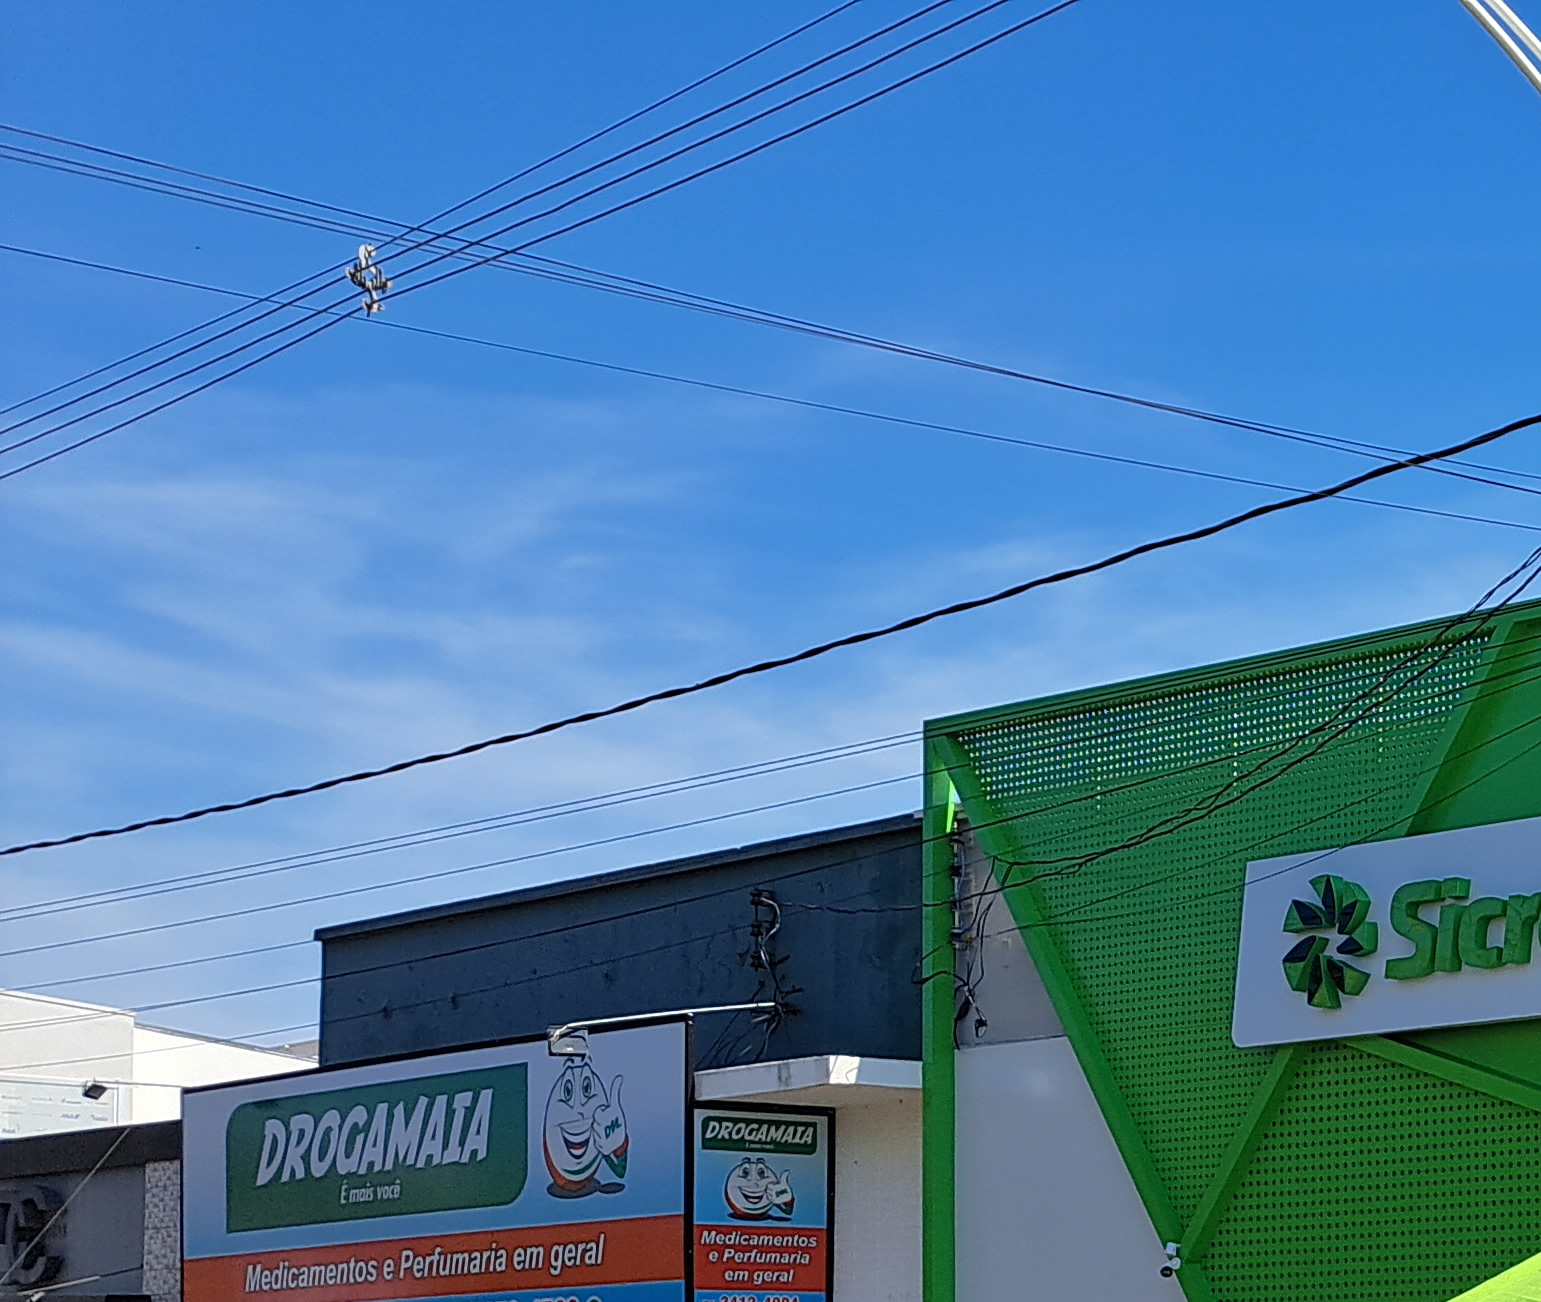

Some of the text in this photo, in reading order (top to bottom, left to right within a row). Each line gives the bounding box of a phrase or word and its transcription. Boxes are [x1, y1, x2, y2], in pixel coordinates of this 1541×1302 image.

[256, 1088, 494, 1187] DROGAMAIA
[705, 1121, 814, 1145] DROGAMAIA
[349, 1183, 374, 1203] mais
[377, 1179, 401, 1201] você
[701, 1230, 817, 1247] Medicamentos
[245, 1233, 605, 1292] Medicamentos e Perfumaria em geral
[709, 1249, 810, 1264] e Perfumaria
[724, 1269, 794, 1284] em geral
